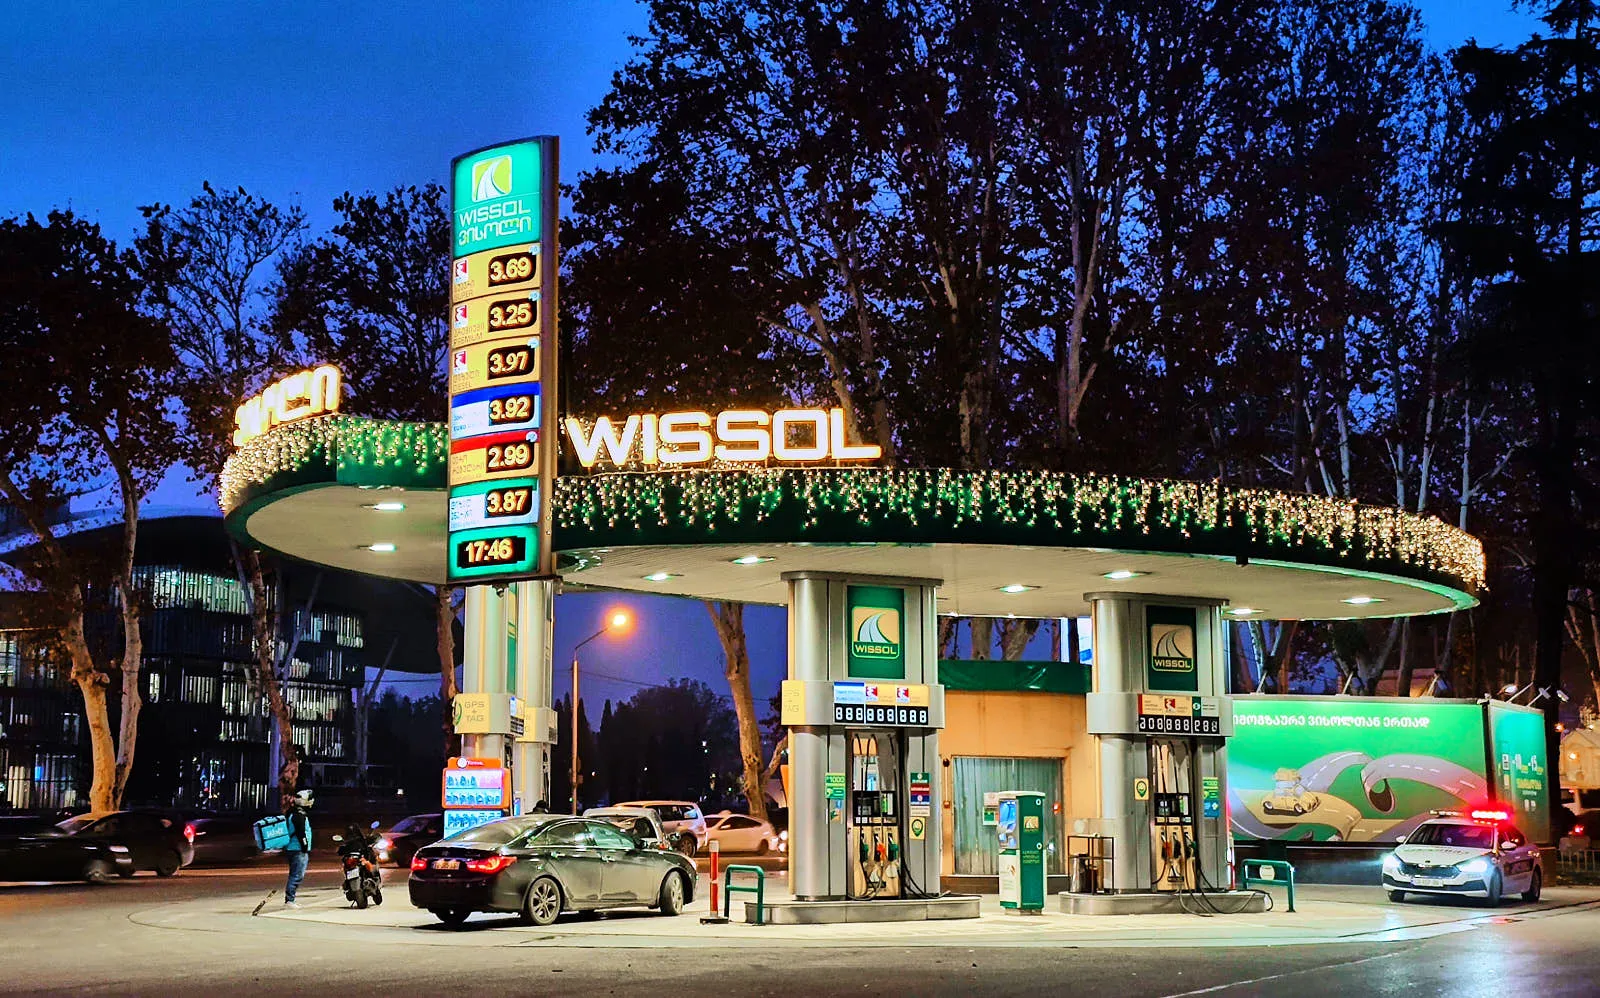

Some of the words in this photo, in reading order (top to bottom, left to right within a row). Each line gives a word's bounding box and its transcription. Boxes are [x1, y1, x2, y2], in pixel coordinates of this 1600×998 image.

[459, 199, 531, 227] WISSOL
[490, 256, 531, 281] 3.69
[490, 303, 532, 327] 3.25
[489, 351, 528, 373] 3.97
[489, 396, 529, 420] 3.92
[565, 408, 882, 467] WISSOL
[487, 444, 528, 468] 2.99
[486, 489, 528, 513] 3.87
[465, 538, 513, 563] 17:46
[855, 644, 897, 655] WISSOL
[1154, 659, 1191, 668] WISSOL
[464, 701, 485, 709] GPS
